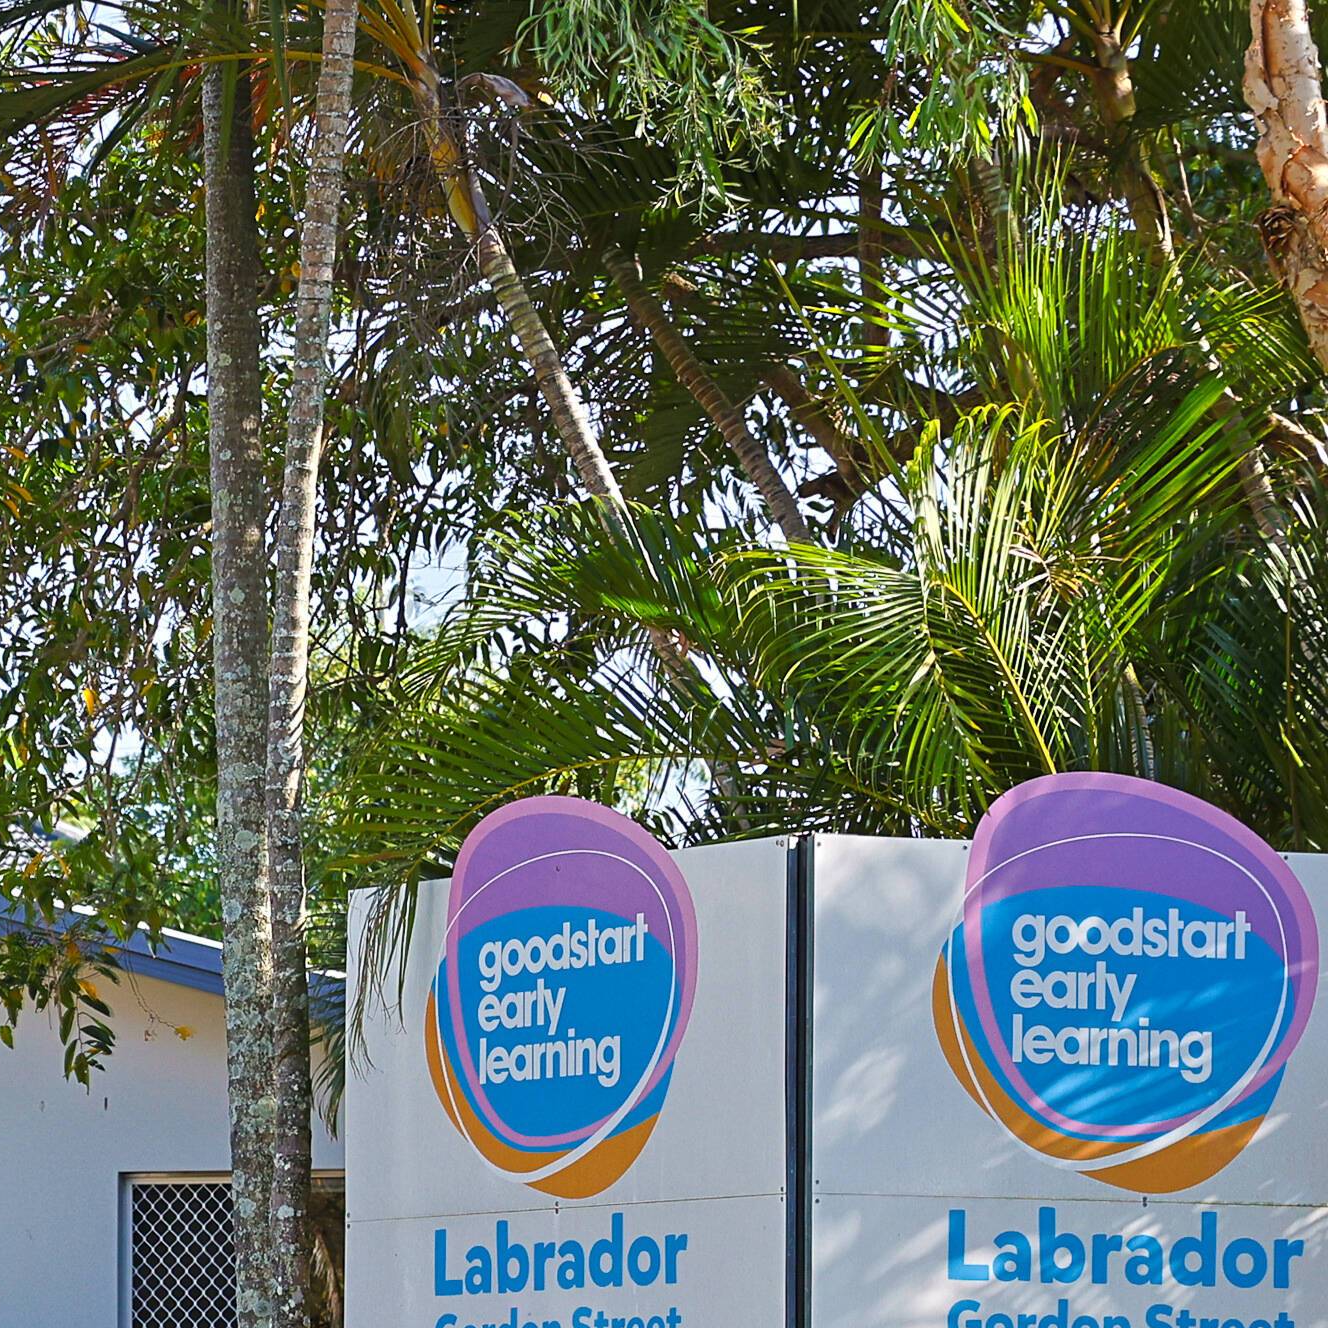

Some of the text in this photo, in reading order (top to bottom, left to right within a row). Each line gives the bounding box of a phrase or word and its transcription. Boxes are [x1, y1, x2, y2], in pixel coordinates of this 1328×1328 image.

[478, 912, 648, 992] goodstart
[1011, 907, 1251, 967] goodstart
[477, 978, 566, 1035] early
[1010, 960, 1137, 1022] early
[479, 1028, 621, 1088] learning
[1011, 1013, 1213, 1084] learning
[434, 1212, 688, 1297] Labrador
[947, 1206, 1305, 1289] Labrador
